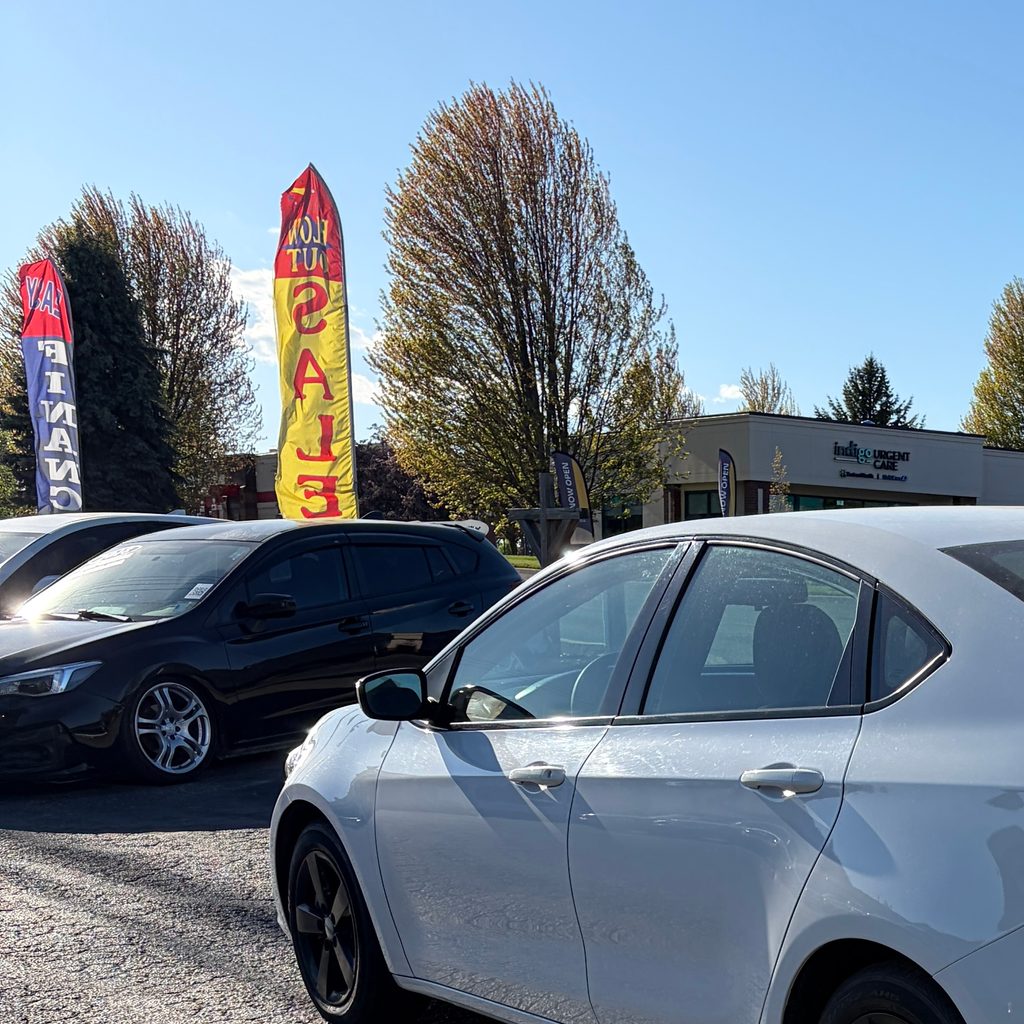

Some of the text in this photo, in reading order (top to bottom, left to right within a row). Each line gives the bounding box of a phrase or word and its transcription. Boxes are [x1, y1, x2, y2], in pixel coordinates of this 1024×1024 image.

[833, 441, 910, 464] indigo URGENT
[561, 462, 572, 486] OPEN
[873, 460, 899, 471] CARE
